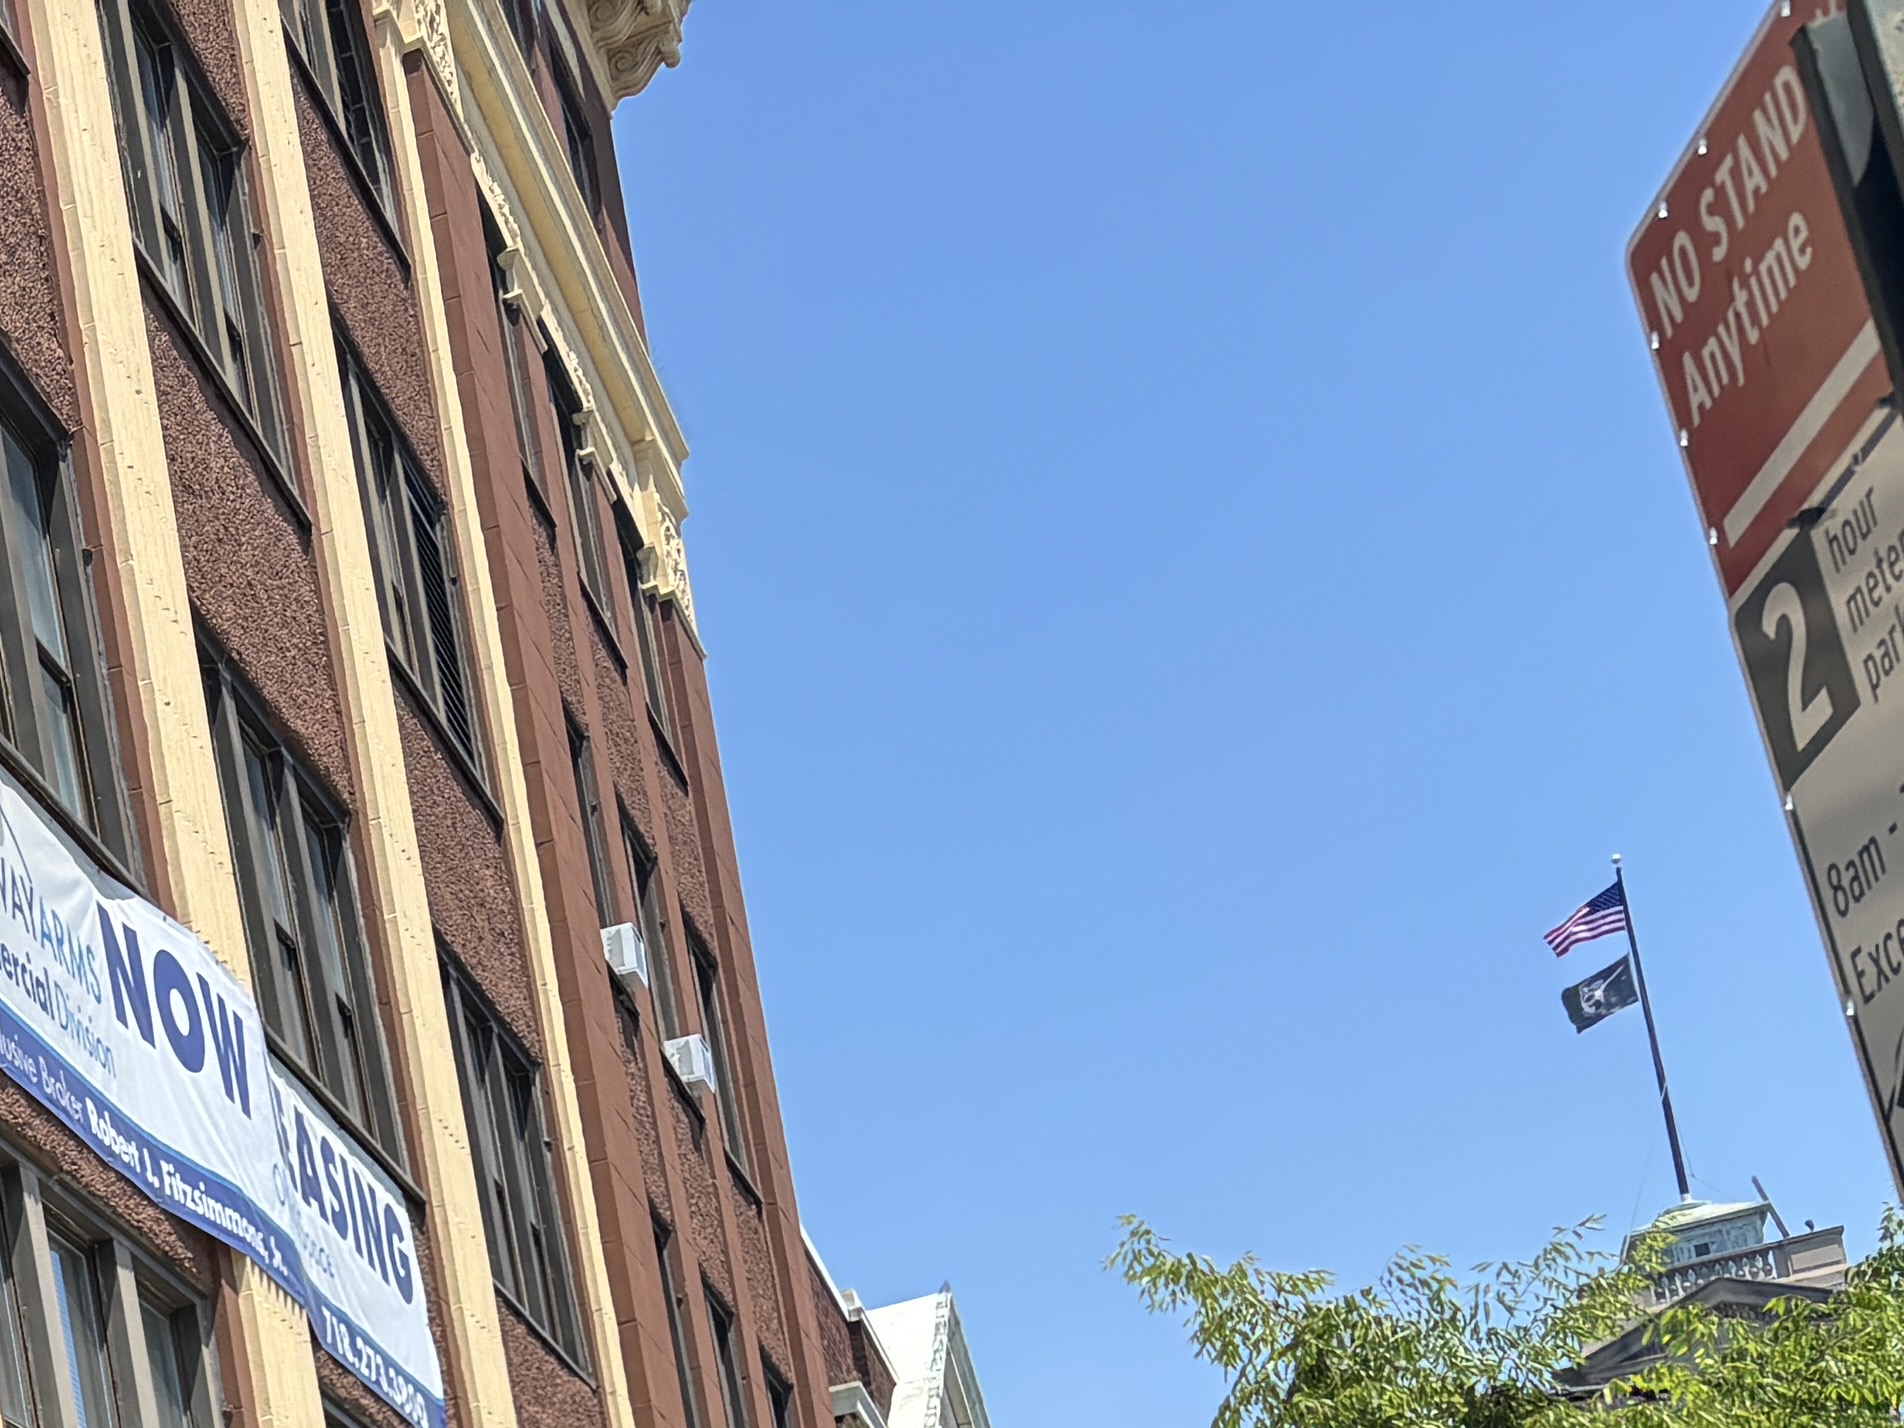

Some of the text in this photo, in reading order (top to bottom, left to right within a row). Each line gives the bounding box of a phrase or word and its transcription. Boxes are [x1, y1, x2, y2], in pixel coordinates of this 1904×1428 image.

[1650, 65, 1808, 339] NO STAND
[1683, 211, 1813, 428] Anytime
[1825, 485, 1878, 574] hour
[1761, 581, 1834, 752] 2
[1827, 836, 1886, 917] 8am
[96, 900, 251, 1120] NOW
[41, 1057, 84, 1124] Broker
[85, 1097, 141, 1172] Robert
